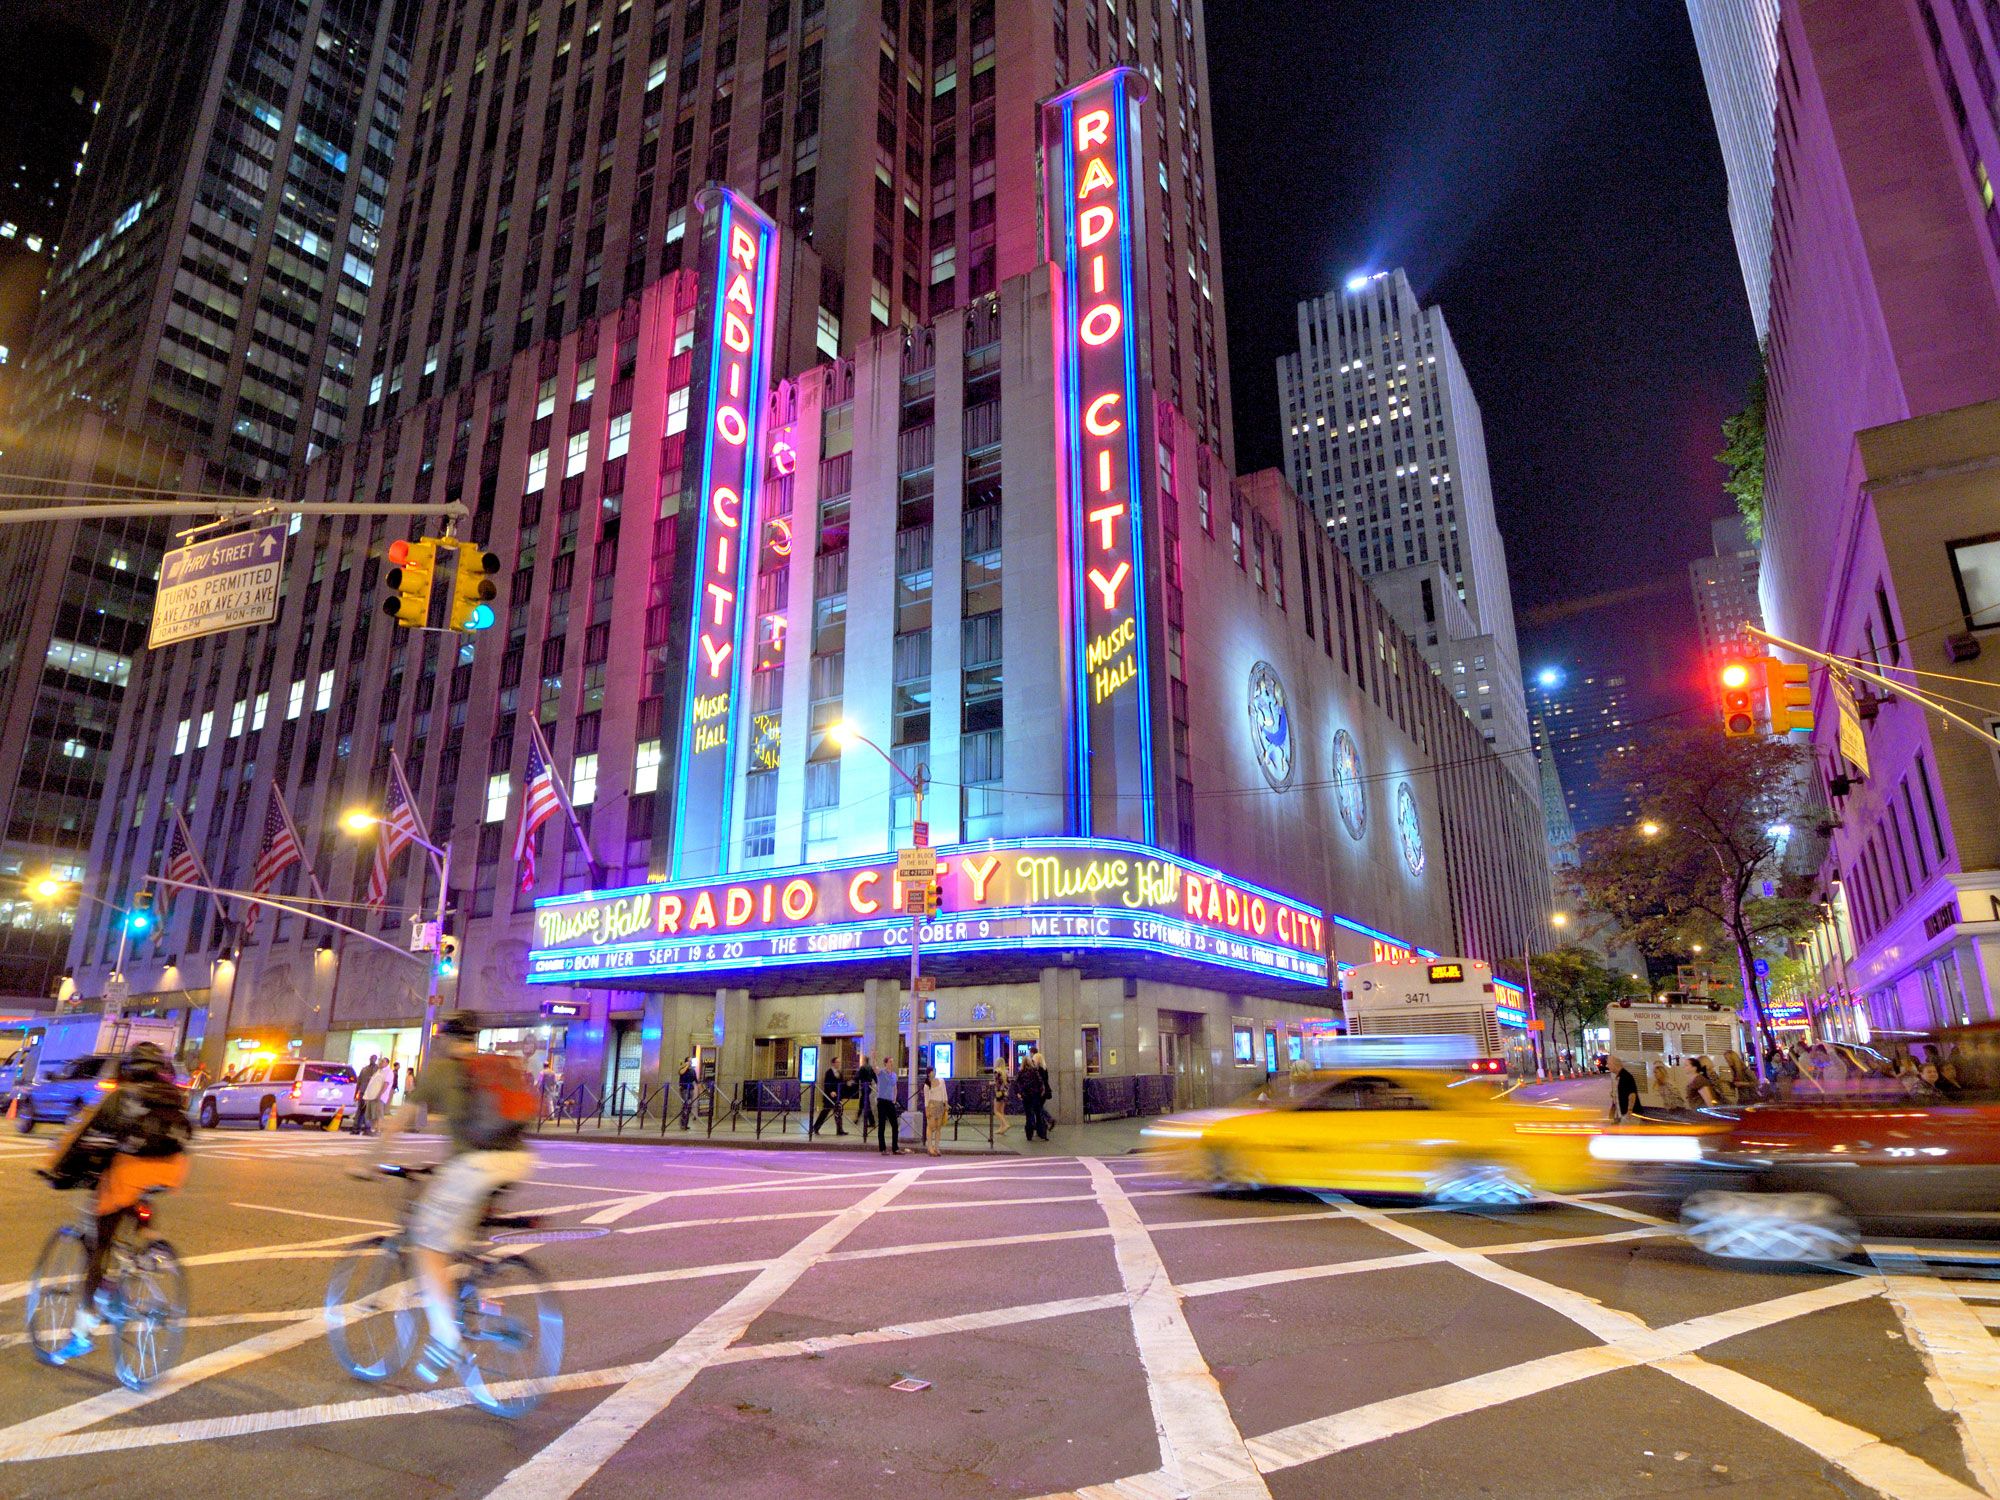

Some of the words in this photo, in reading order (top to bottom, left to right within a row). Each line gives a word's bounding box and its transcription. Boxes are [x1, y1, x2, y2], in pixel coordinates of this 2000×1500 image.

[1078, 109, 1121, 346] RADIO
[716, 225, 756, 446] RADIO
[1085, 393, 1130, 610] CITY
[180, 553, 210, 575] THRU
[211, 542, 255, 566] STREET
[163, 585, 198, 607] TURNS
[204, 568, 272, 597] PERMITTED
[163, 607, 179, 623] AVE
[188, 600, 212, 616] PARK
[214, 593, 233, 611] AVE
[244, 591, 251, 605] 3
[255, 586, 274, 602] AVE
[701, 487, 740, 678] CITY
[225, 605, 266, 621] MON-FRI
[539, 905, 601, 948] Music
[593, 894, 652, 945] Hall
[657, 879, 815, 934] RADIO
[1016, 856, 1129, 903] Music
[1122, 861, 1178, 908] Hall
[1186, 873, 1267, 935] RADIO
[1277, 905, 1322, 951] CITY
[573, 954, 599, 970] BON
[605, 951, 633, 968] IVER
[649, 949, 680, 965] SEPT
[688, 946, 700, 961] 19
[723, 942, 743, 959] 20
[770, 936, 796, 955] THE
[807, 930, 863, 953] SCRIPT
[883, 922, 968, 946] OCOBER
[979, 920, 990, 938] 9
[1031, 917, 1110, 936] METRIC
[1133, 920, 1191, 948] SEPTEMBER
[1194, 934, 1206, 951] 23
[1215, 939, 1228, 955] ON
[1231, 942, 1249, 961] SALE
[1405, 992, 1430, 1004] 3471
[1655, 1021, 1691, 1032] SLOW!
